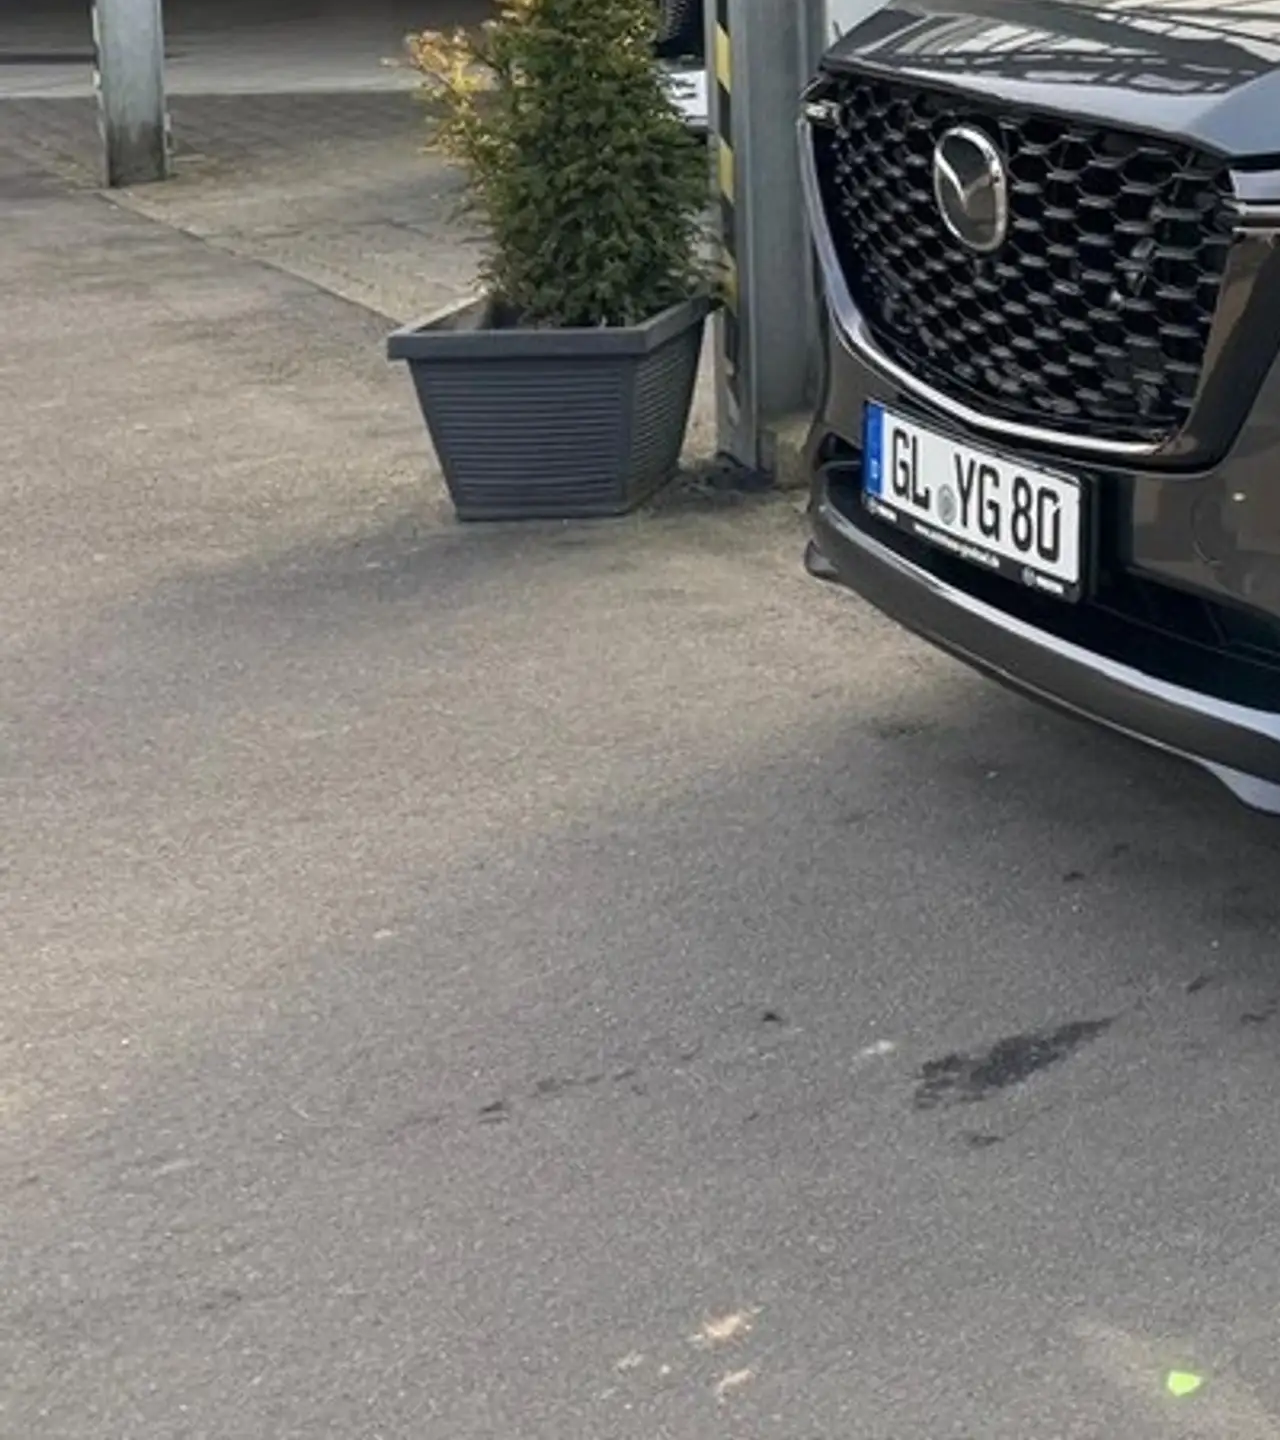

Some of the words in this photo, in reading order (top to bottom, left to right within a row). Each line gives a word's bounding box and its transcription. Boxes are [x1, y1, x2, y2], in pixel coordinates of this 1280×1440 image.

[892, 427, 930, 511] GL
[954, 453, 1000, 542] YG
[1011, 475, 1061, 564] 80
